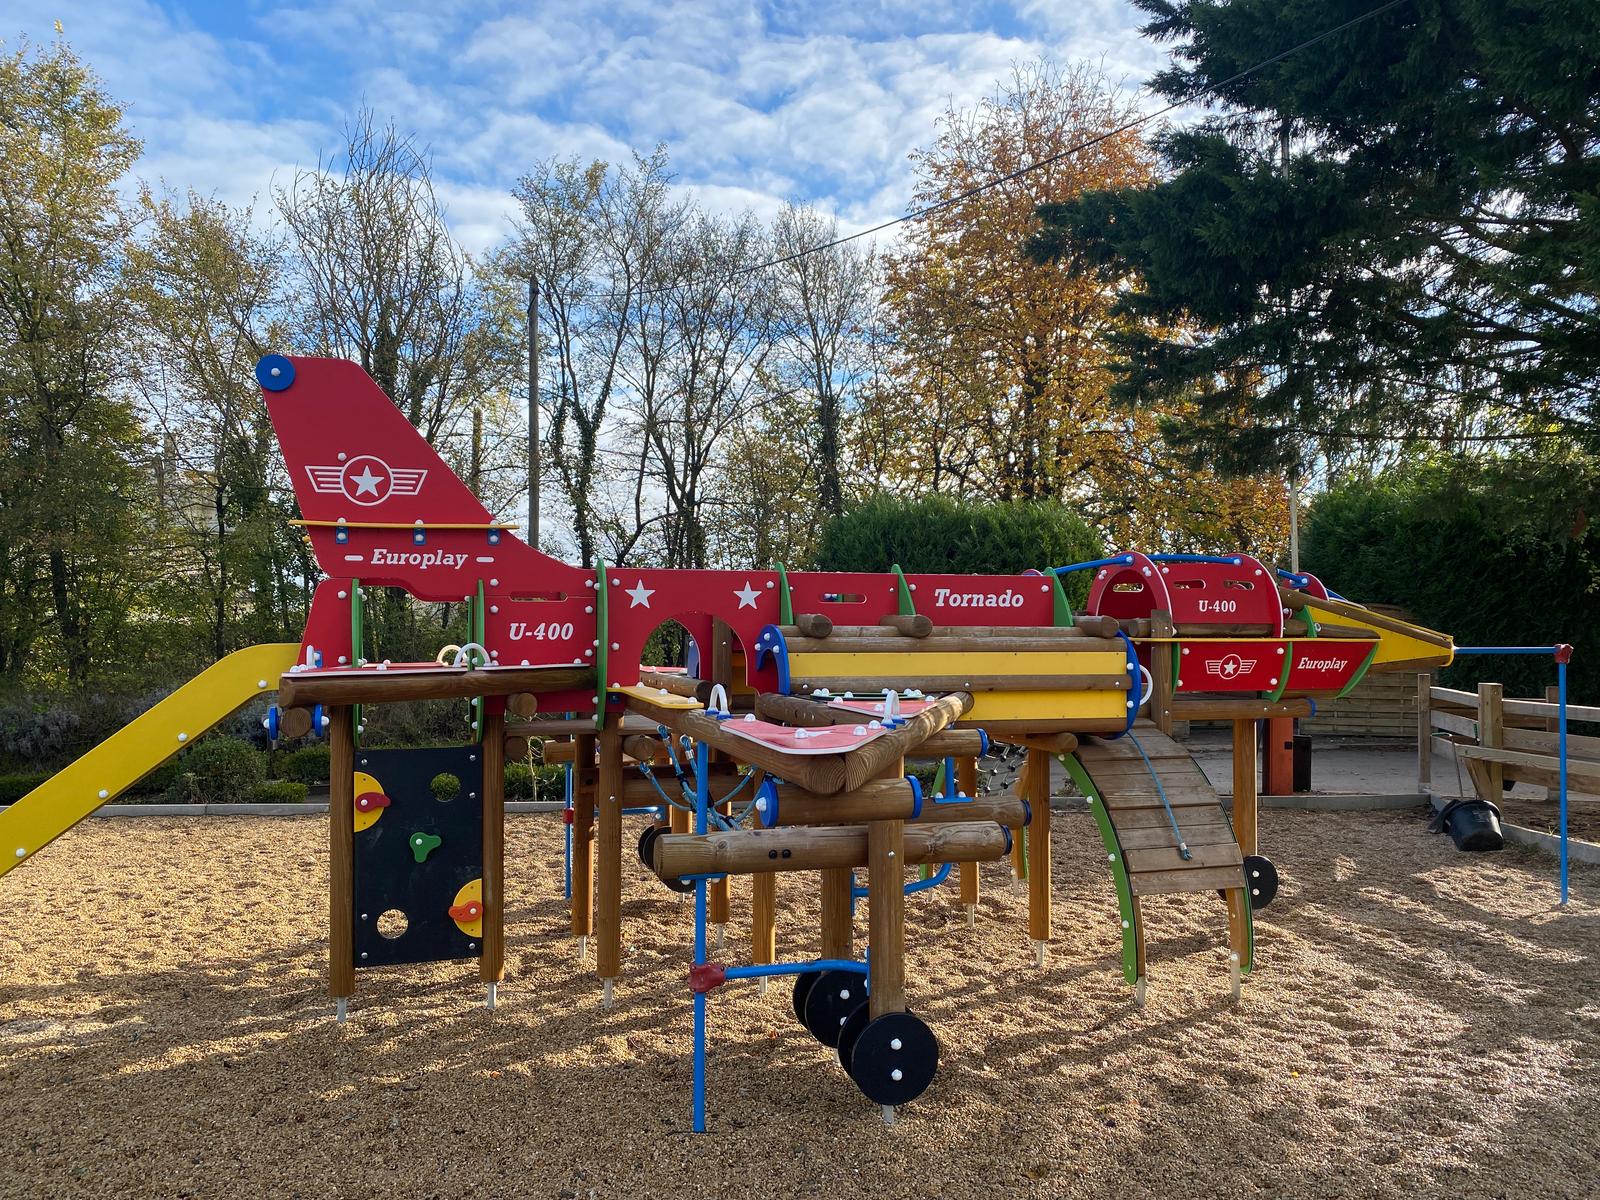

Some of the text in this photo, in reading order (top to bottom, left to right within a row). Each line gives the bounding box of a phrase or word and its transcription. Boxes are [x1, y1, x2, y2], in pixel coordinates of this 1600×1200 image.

[371, 548, 469, 570] Europlay
[934, 588, 1024, 608] Tornado
[1198, 599, 1237, 613] U-400
[509, 622, 574, 641] U-400
[1297, 657, 1348, 674] Europlay
